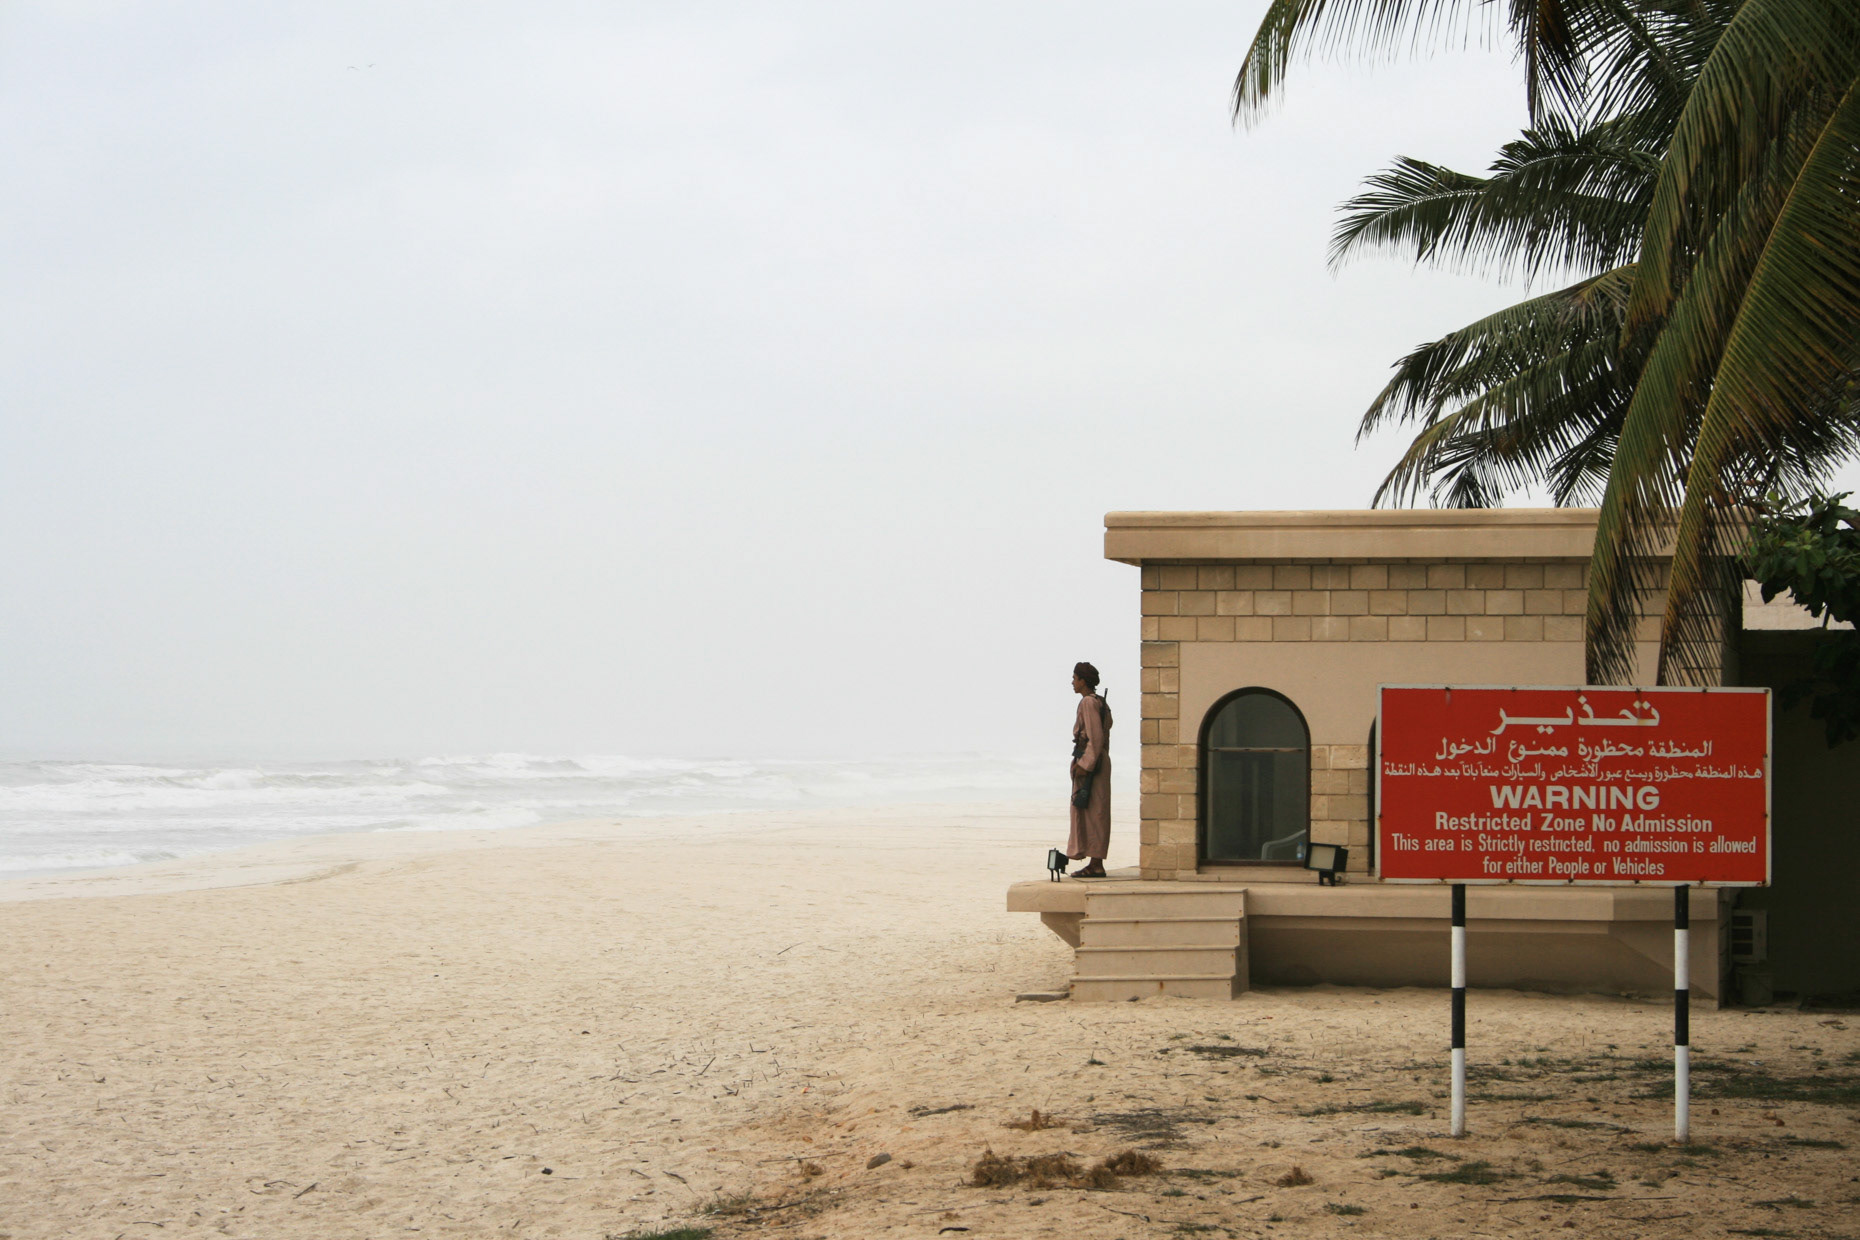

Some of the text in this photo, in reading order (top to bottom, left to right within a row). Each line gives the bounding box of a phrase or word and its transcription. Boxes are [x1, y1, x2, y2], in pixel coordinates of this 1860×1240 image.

[1490, 696, 1659, 735] تحذير
[1436, 737, 1712, 763] المنطقة محظورة ممنوع الدخول
[1385, 762, 1415, 775] النقطة
[1417, 763, 1441, 776] هذه
[1444, 769, 1460, 779] بعد
[1502, 763, 1545, 780] والسيارات
[1600, 770, 1622, 781] عبور
[1625, 770, 1653, 781] ويمنع
[1655, 766, 1693, 781] محظورة
[1695, 765, 1735, 778] المنطقة
[1738, 766, 1762, 778] هذه
[1490, 786, 1659, 810] WARNING
[1436, 812, 1712, 832] Restricted Zone No Admission
[1392, 833, 1419, 850] This
[1425, 839, 1454, 850] area
[1462, 835, 1472, 851] is
[1479, 833, 1525, 857] Strictly
[1604, 840, 1619, 852] no
[1625, 836, 1687, 852] admission
[1694, 837, 1704, 852] is
[1710, 836, 1755, 853] allowed
[1483, 856, 1664, 878] for either People or Vehicles
